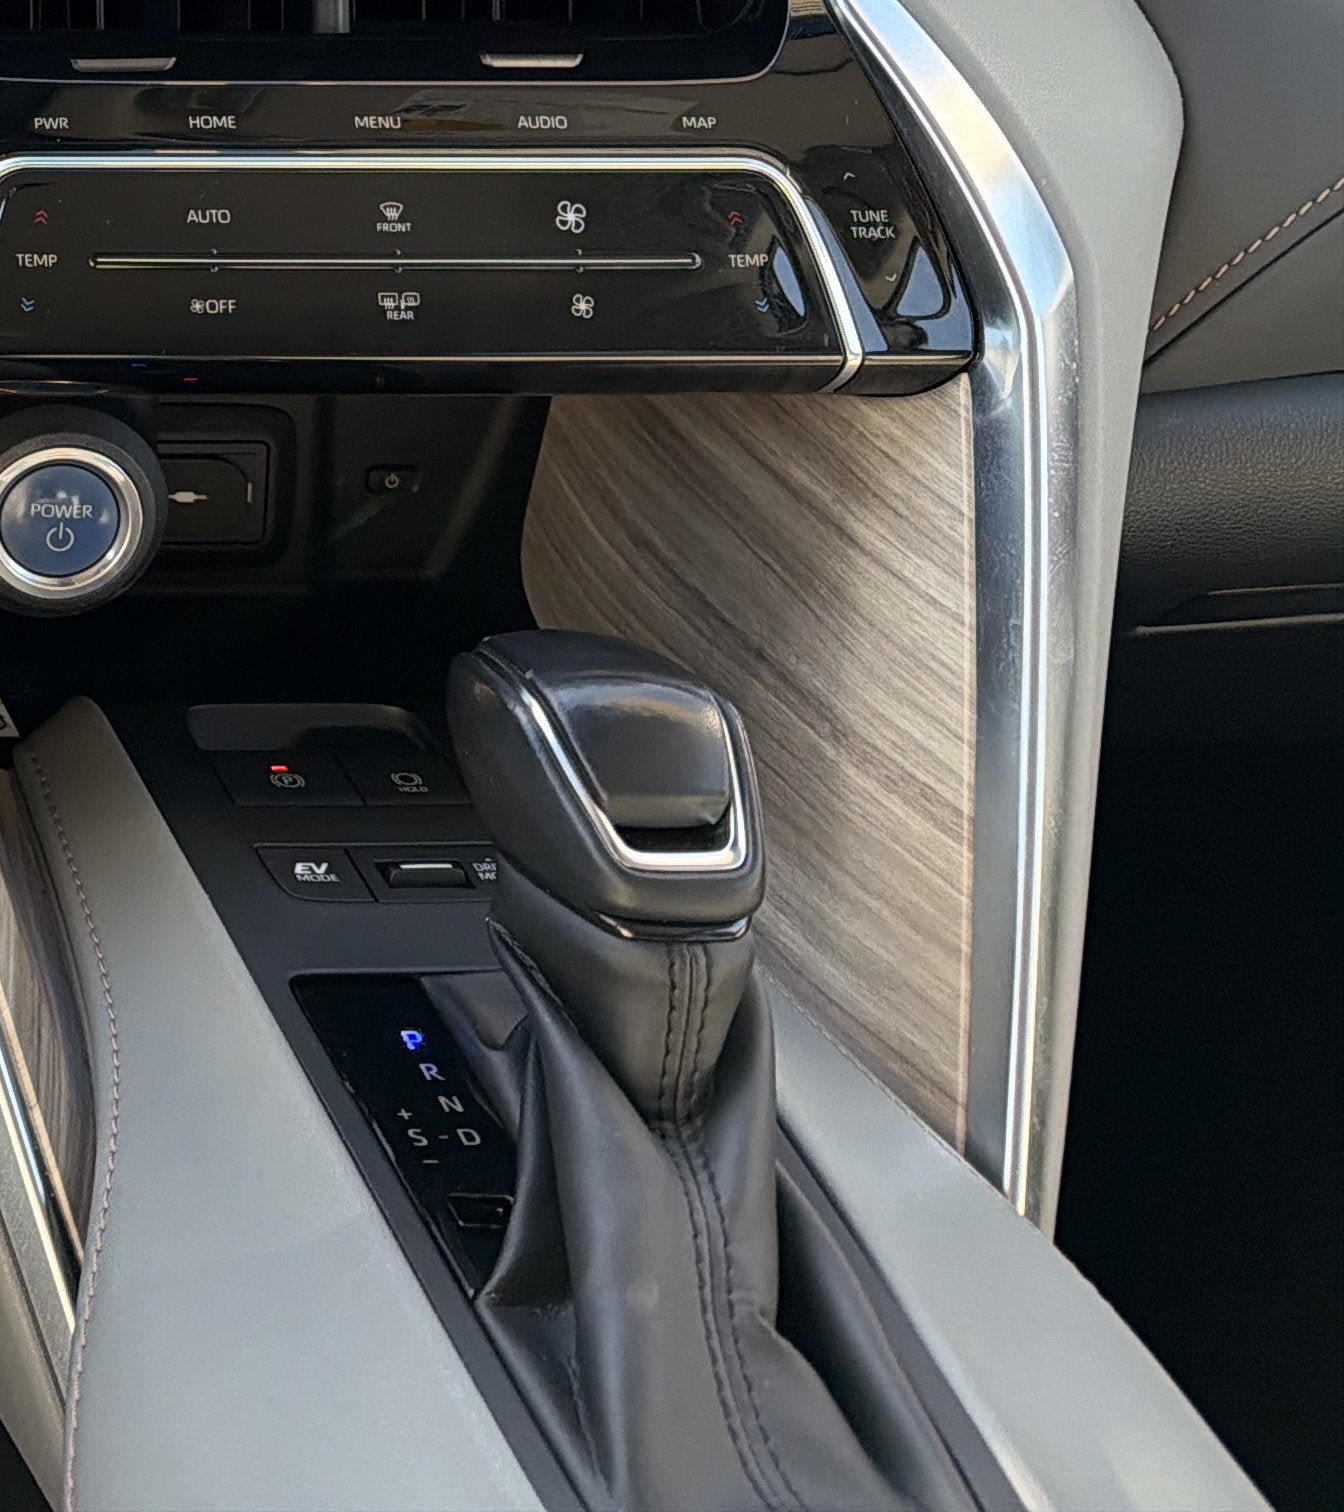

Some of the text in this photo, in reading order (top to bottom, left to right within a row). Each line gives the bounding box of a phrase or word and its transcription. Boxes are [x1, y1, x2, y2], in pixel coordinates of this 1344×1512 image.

[34, 116, 70, 130] PWR
[188, 115, 236, 130] HOME
[354, 115, 402, 130] MENU
[518, 115, 568, 130] AUDIO
[682, 115, 717, 130] MAP
[187, 208, 231, 225] AUTO
[850, 209, 889, 224] TUNE
[376, 222, 412, 233] FRONT
[850, 225, 896, 240] TRACK
[16, 253, 58, 269] TEMP
[728, 252, 769, 269] TEMP
[206, 299, 237, 315] OFF
[386, 310, 414, 320] REAR
[30, 503, 94, 520] POWER
[294, 862, 329, 874] EV
[295, 874, 341, 883] MODE
[400, 1031, 423, 1050] P
[418, 1063, 446, 1081] R
[439, 1095, 465, 1113] N
[408, 1128, 482, 1146] S D
